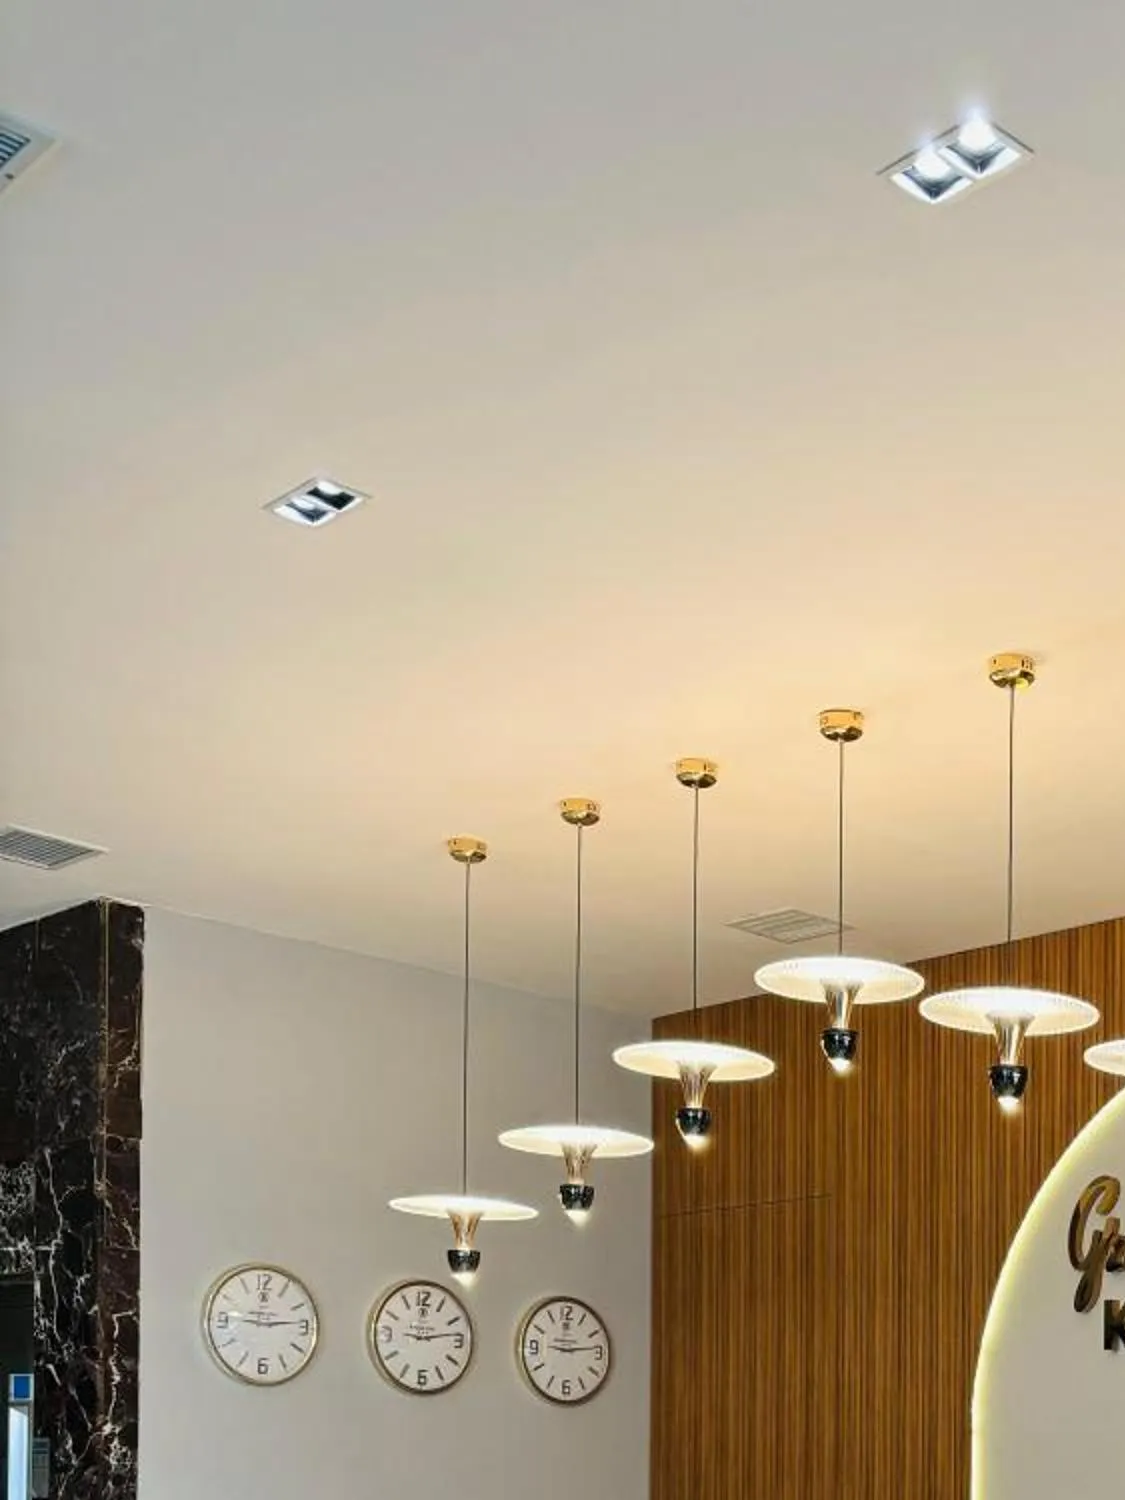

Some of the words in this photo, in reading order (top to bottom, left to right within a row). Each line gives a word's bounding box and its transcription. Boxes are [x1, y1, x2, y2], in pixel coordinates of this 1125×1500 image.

[256, 1273, 273, 1291] 12
[416, 1291, 432, 1307] 12
[559, 1305, 573, 1321] 12
[298, 1319, 309, 1337] 3
[453, 1332, 465, 1349] 3
[528, 1339, 539, 1355] 9
[593, 1344, 603, 1361] 3
[257, 1357, 269, 1375] 6
[417, 1369, 428, 1386] 6
[561, 1379, 571, 1395] 6
